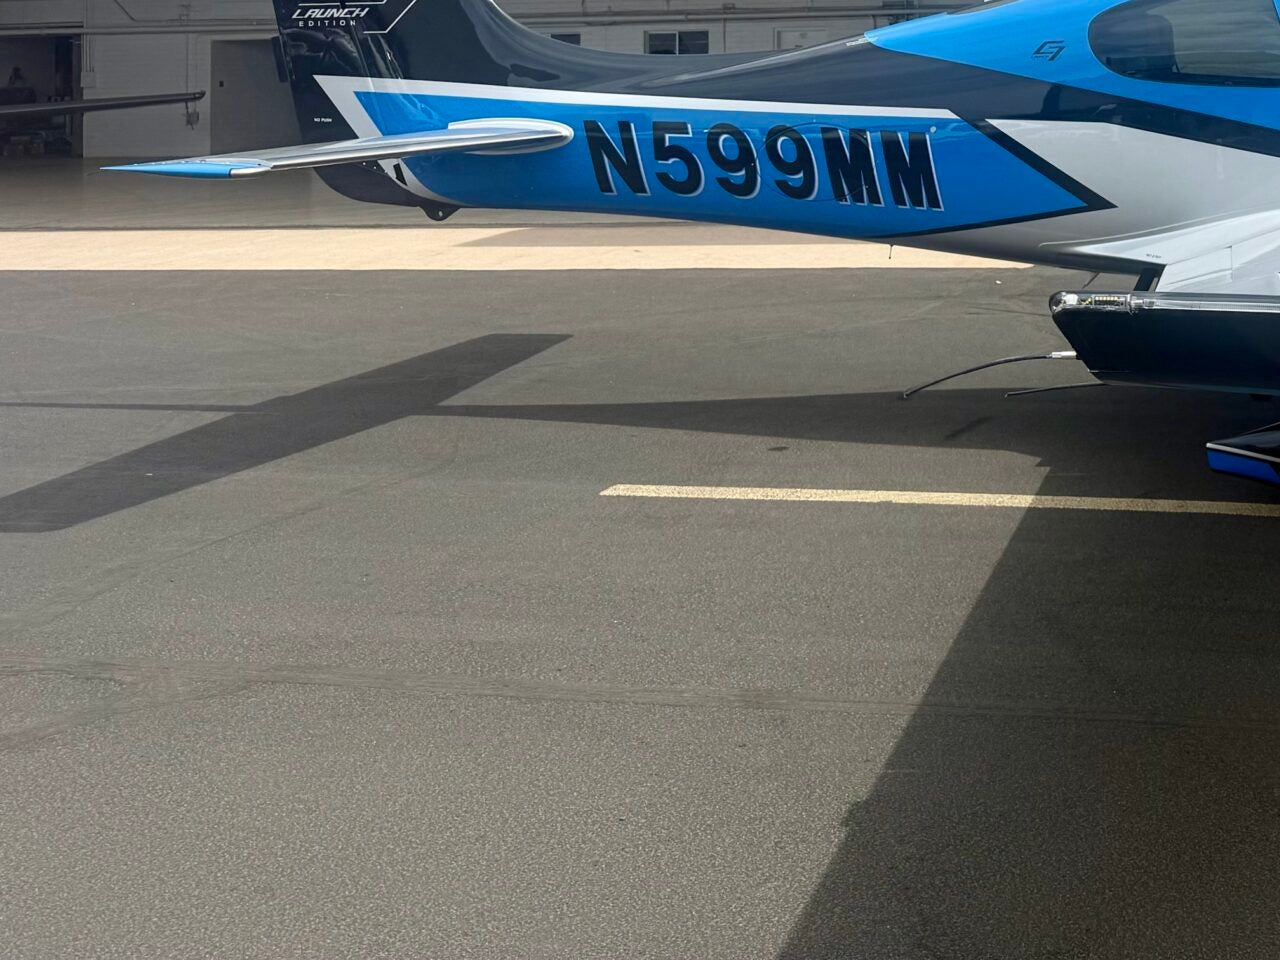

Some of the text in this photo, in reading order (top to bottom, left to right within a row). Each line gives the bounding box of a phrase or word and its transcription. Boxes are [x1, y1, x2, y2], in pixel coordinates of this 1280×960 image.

[291, 7, 370, 19] LAUNCH
[299, 19, 356, 27] EDITION
[583, 119, 945, 211] N599MM
